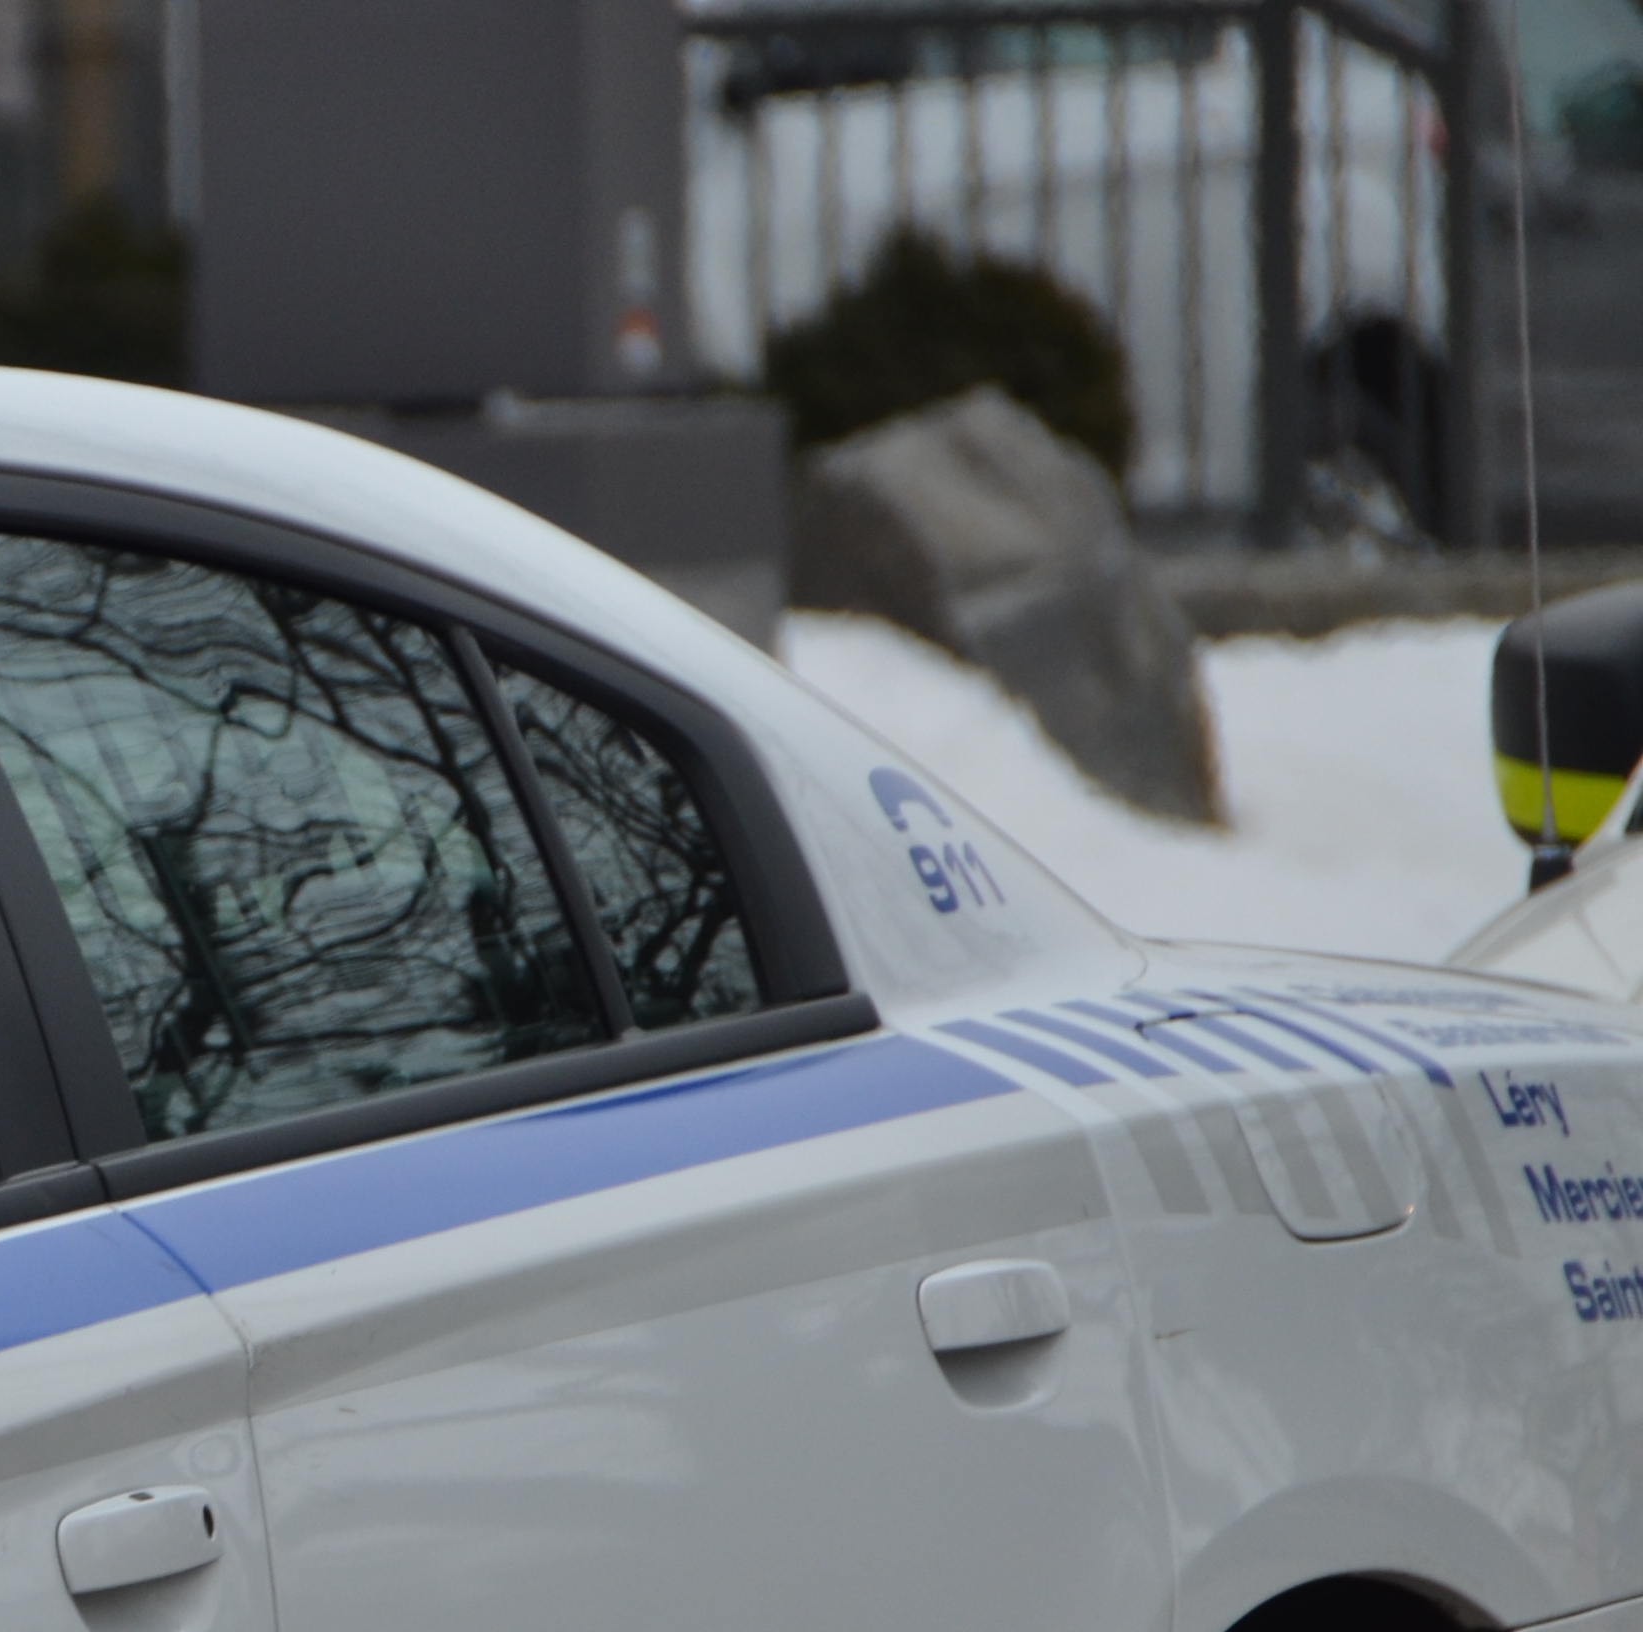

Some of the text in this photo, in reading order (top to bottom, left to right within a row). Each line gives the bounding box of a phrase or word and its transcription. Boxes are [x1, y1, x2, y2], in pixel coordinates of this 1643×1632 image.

[909, 842, 1006, 913] 911
[1479, 1069, 1571, 1138] Léry
[1523, 1162, 1643, 1224] Mercie
